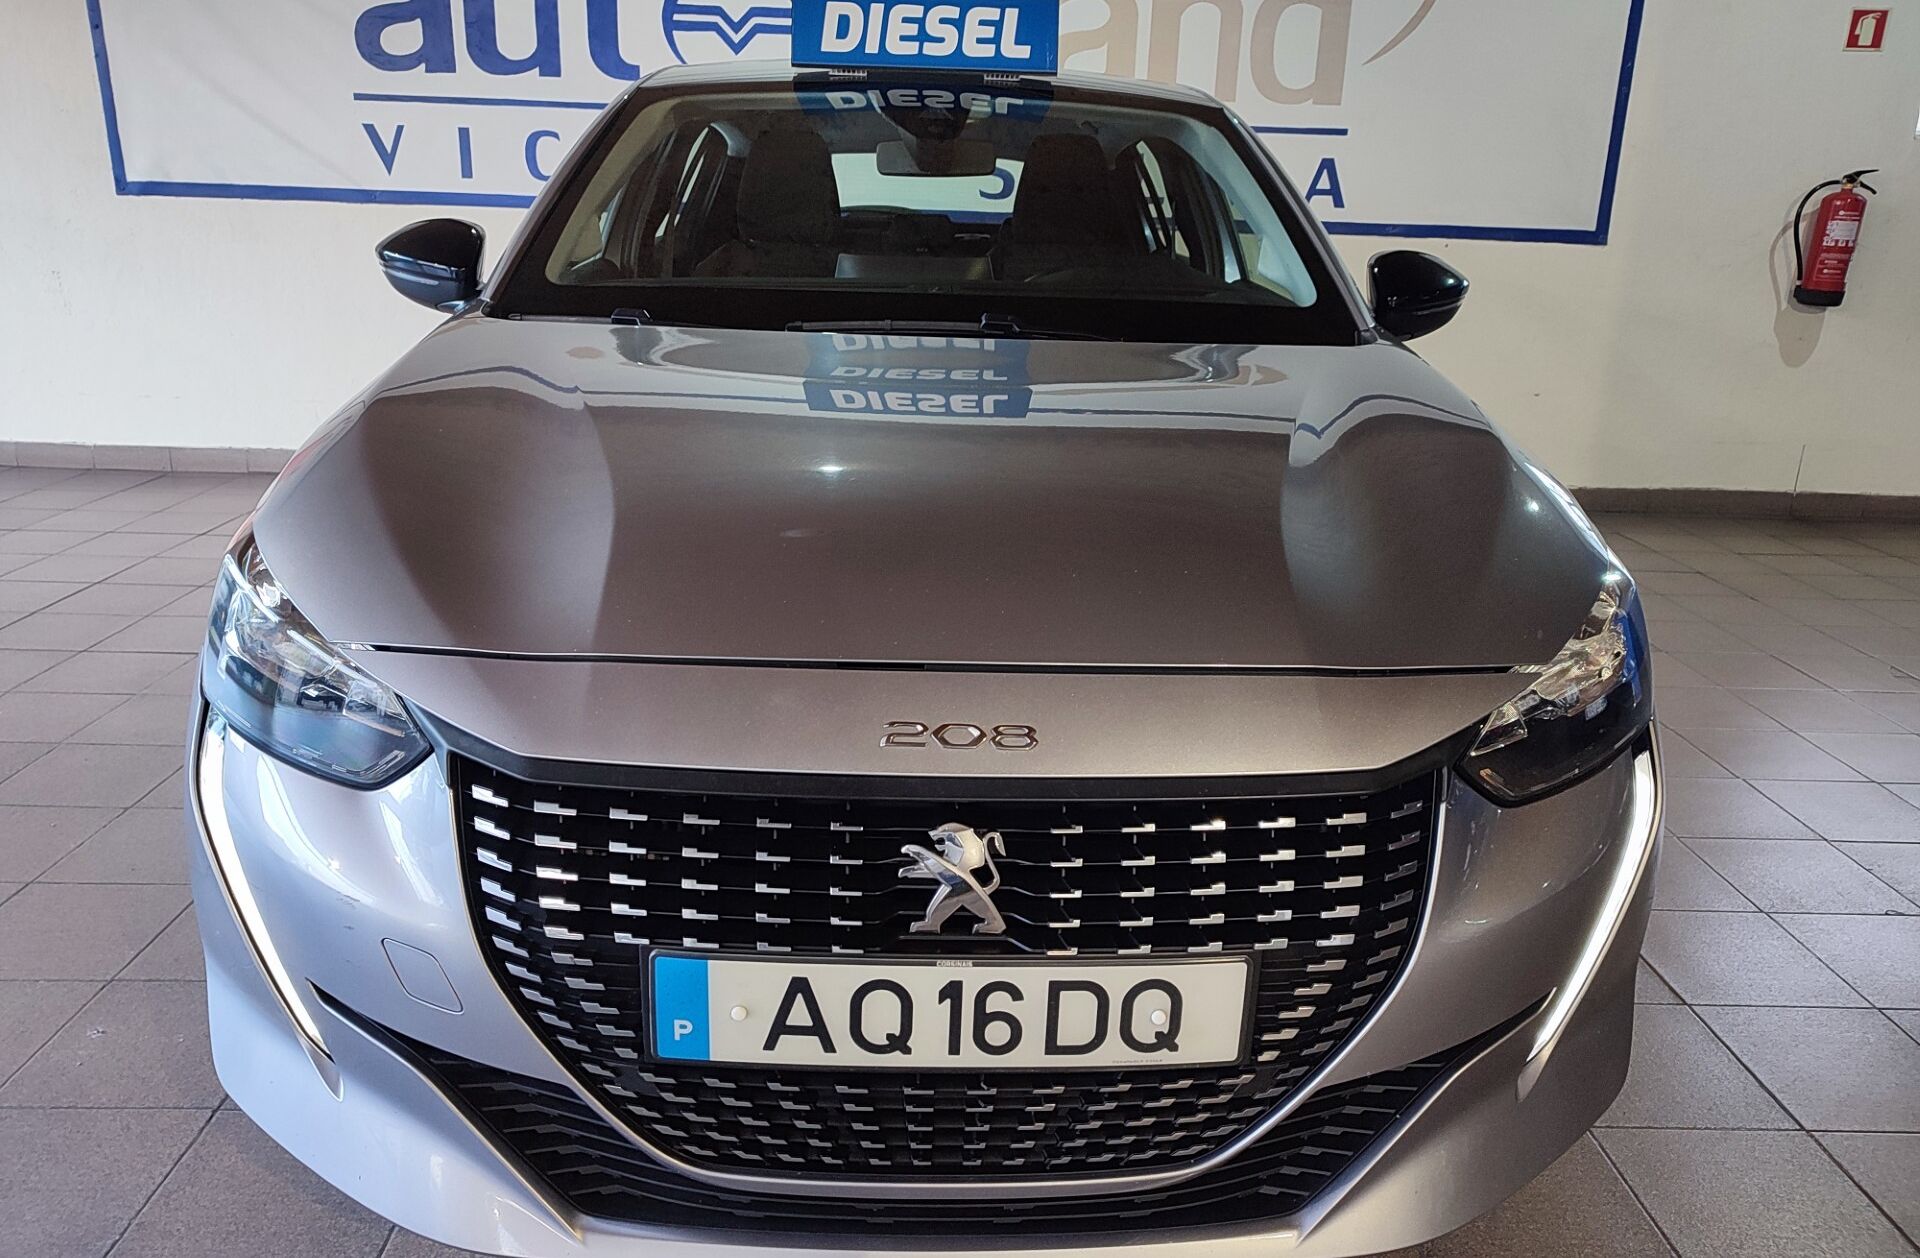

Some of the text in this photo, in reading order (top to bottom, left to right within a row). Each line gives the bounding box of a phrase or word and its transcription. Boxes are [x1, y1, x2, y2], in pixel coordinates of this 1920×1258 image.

[820, 1, 1031, 60] DIESEL
[829, 366, 1008, 381] DIESEL
[879, 721, 1039, 751] 208
[674, 1019, 693, 1041] P
